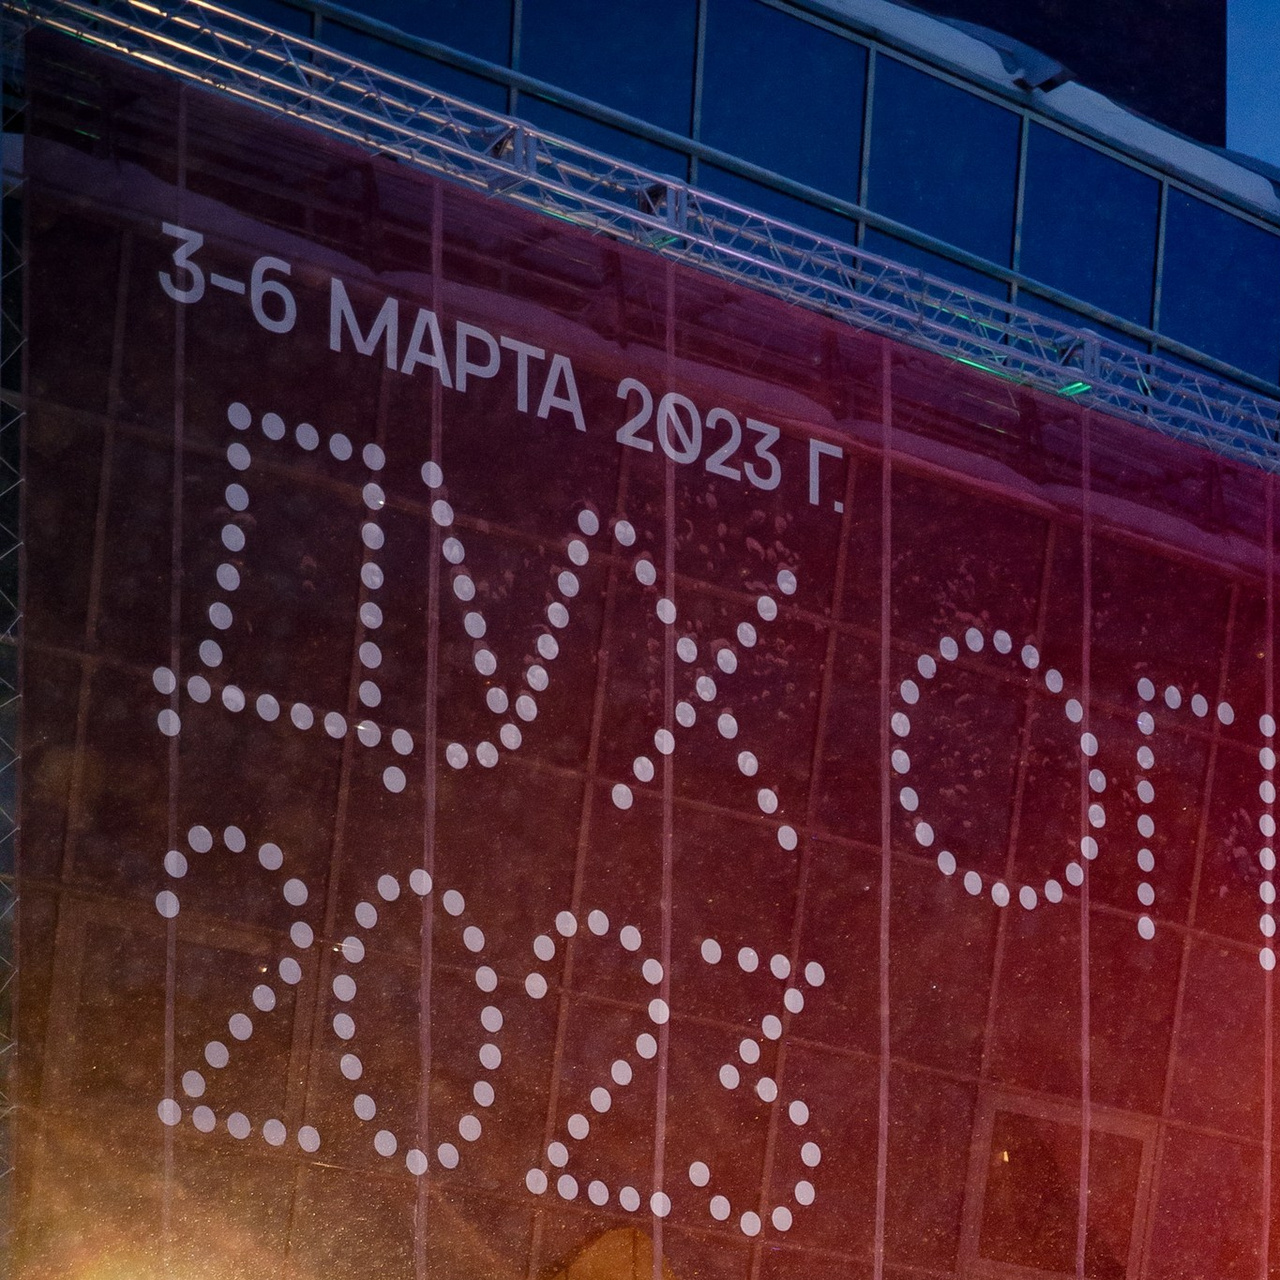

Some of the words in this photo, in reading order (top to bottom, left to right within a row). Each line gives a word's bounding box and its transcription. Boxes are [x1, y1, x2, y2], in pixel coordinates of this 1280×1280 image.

[158, 222, 297, 333] 3-6
[330, 277, 586, 432] МАРТА
[616, 378, 781, 490] 2023
[152, 402, 798, 851] ДУХ
[155, 825, 826, 1237] 2023
